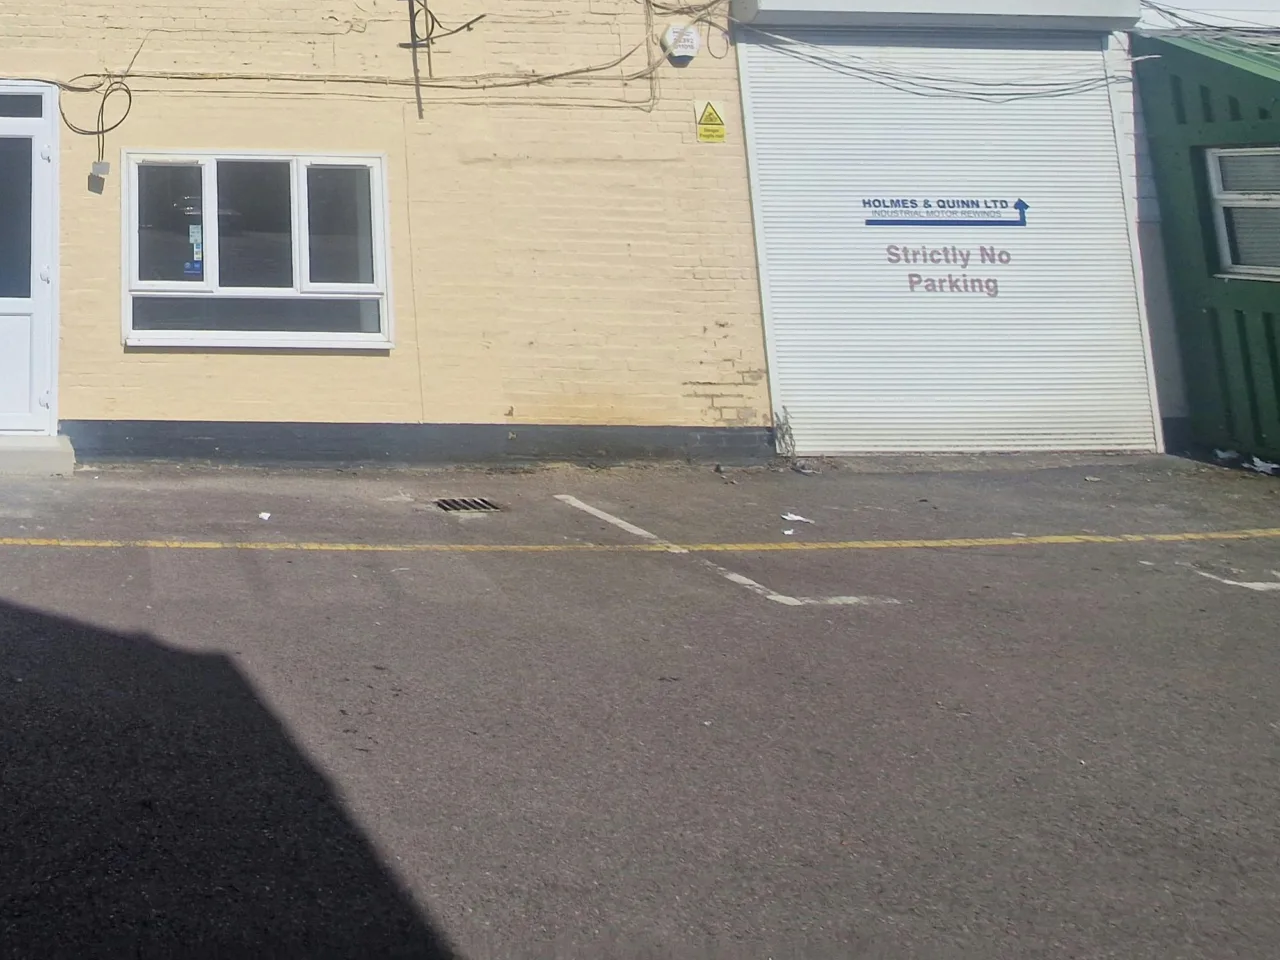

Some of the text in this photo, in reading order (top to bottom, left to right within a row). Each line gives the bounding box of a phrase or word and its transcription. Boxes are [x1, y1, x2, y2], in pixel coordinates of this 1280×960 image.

[862, 199, 1009, 209] HOLMES & QUINN LTD
[871, 210, 1002, 218] INDUSTRIAL MOTOR REWINDS
[886, 245, 1012, 268] Strictly No
[907, 273, 999, 297] Parking
